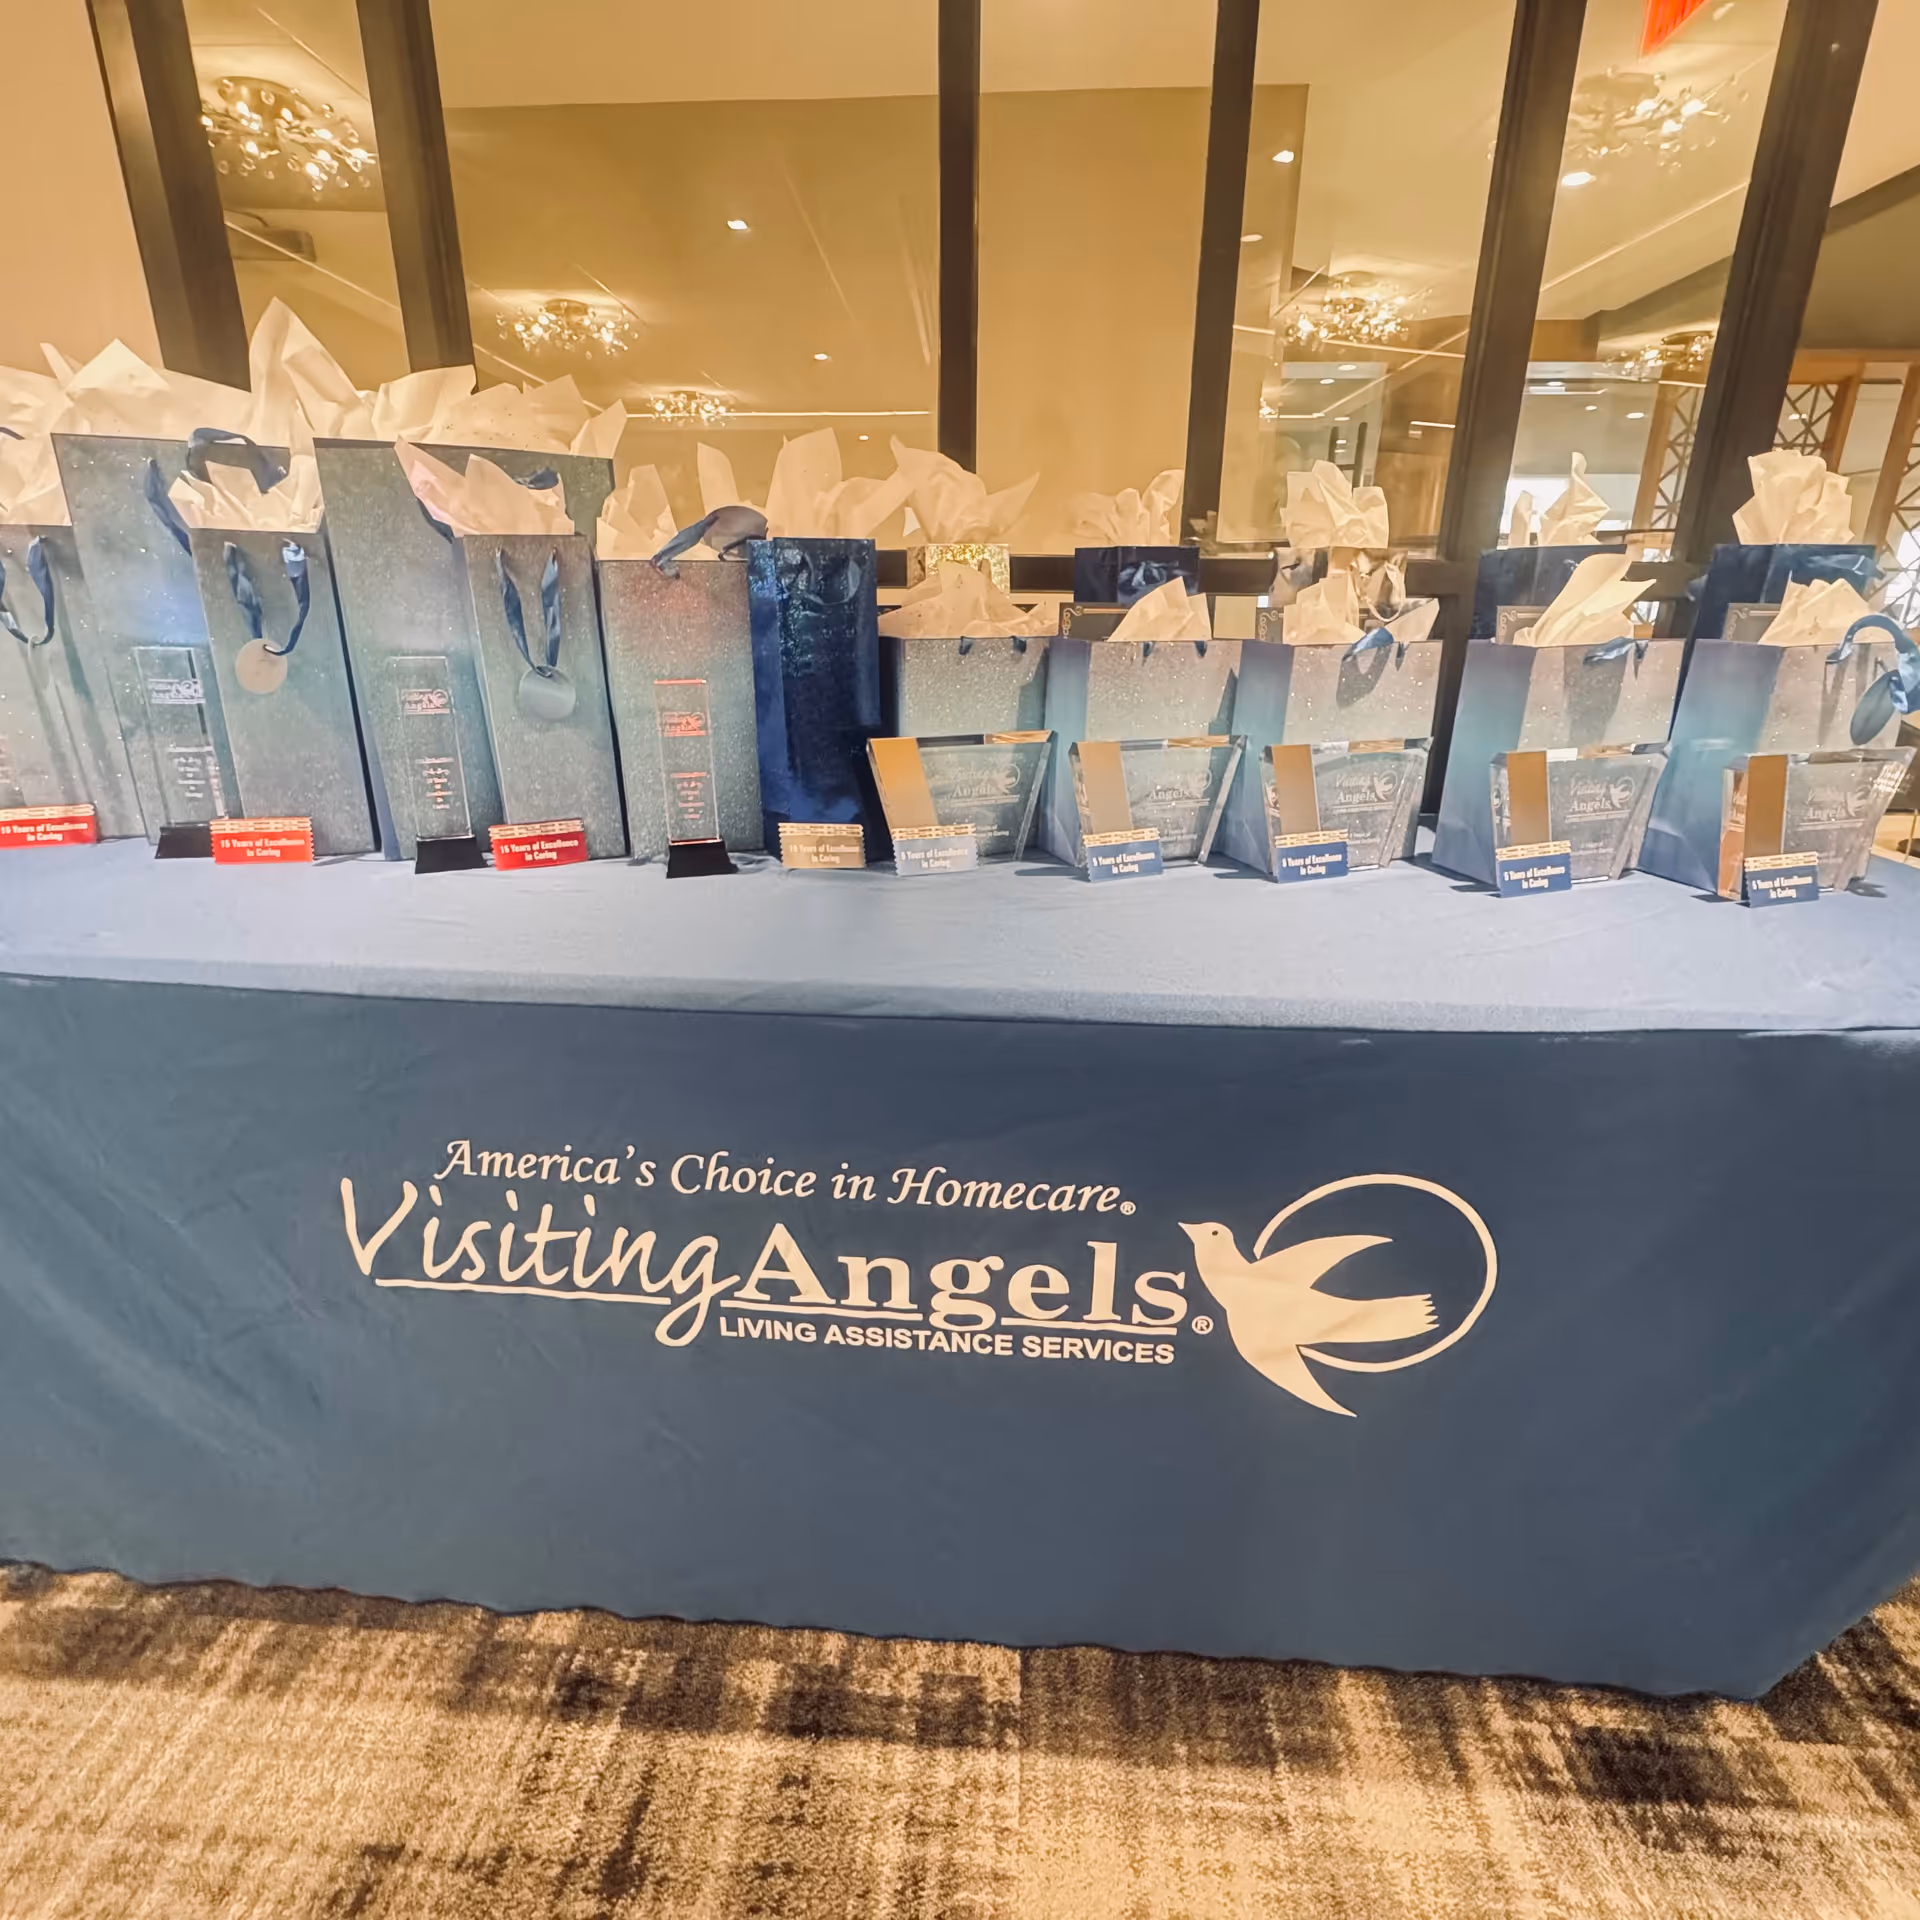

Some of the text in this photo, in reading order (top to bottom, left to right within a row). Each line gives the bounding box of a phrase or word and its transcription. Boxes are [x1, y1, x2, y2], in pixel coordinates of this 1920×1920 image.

[12, 825, 35, 833] Years
[36, 824, 44, 832] of
[36, 833, 63, 841] Caring
[231, 838, 253, 847] Years
[255, 838, 263, 847] of
[510, 843, 531, 852] Years
[532, 842, 540, 851] of
[541, 839, 579, 850] Excellence
[246, 847, 281, 857] in Caring
[524, 851, 558, 861] in Caring
[433, 1140, 656, 1186] America's
[671, 1151, 816, 1198] Choice
[832, 1163, 876, 1201] in
[341, 1178, 1187, 1346] Visiting Angels
[720, 1317, 1174, 1364] LIVING ASSISTANCE SERVICES
